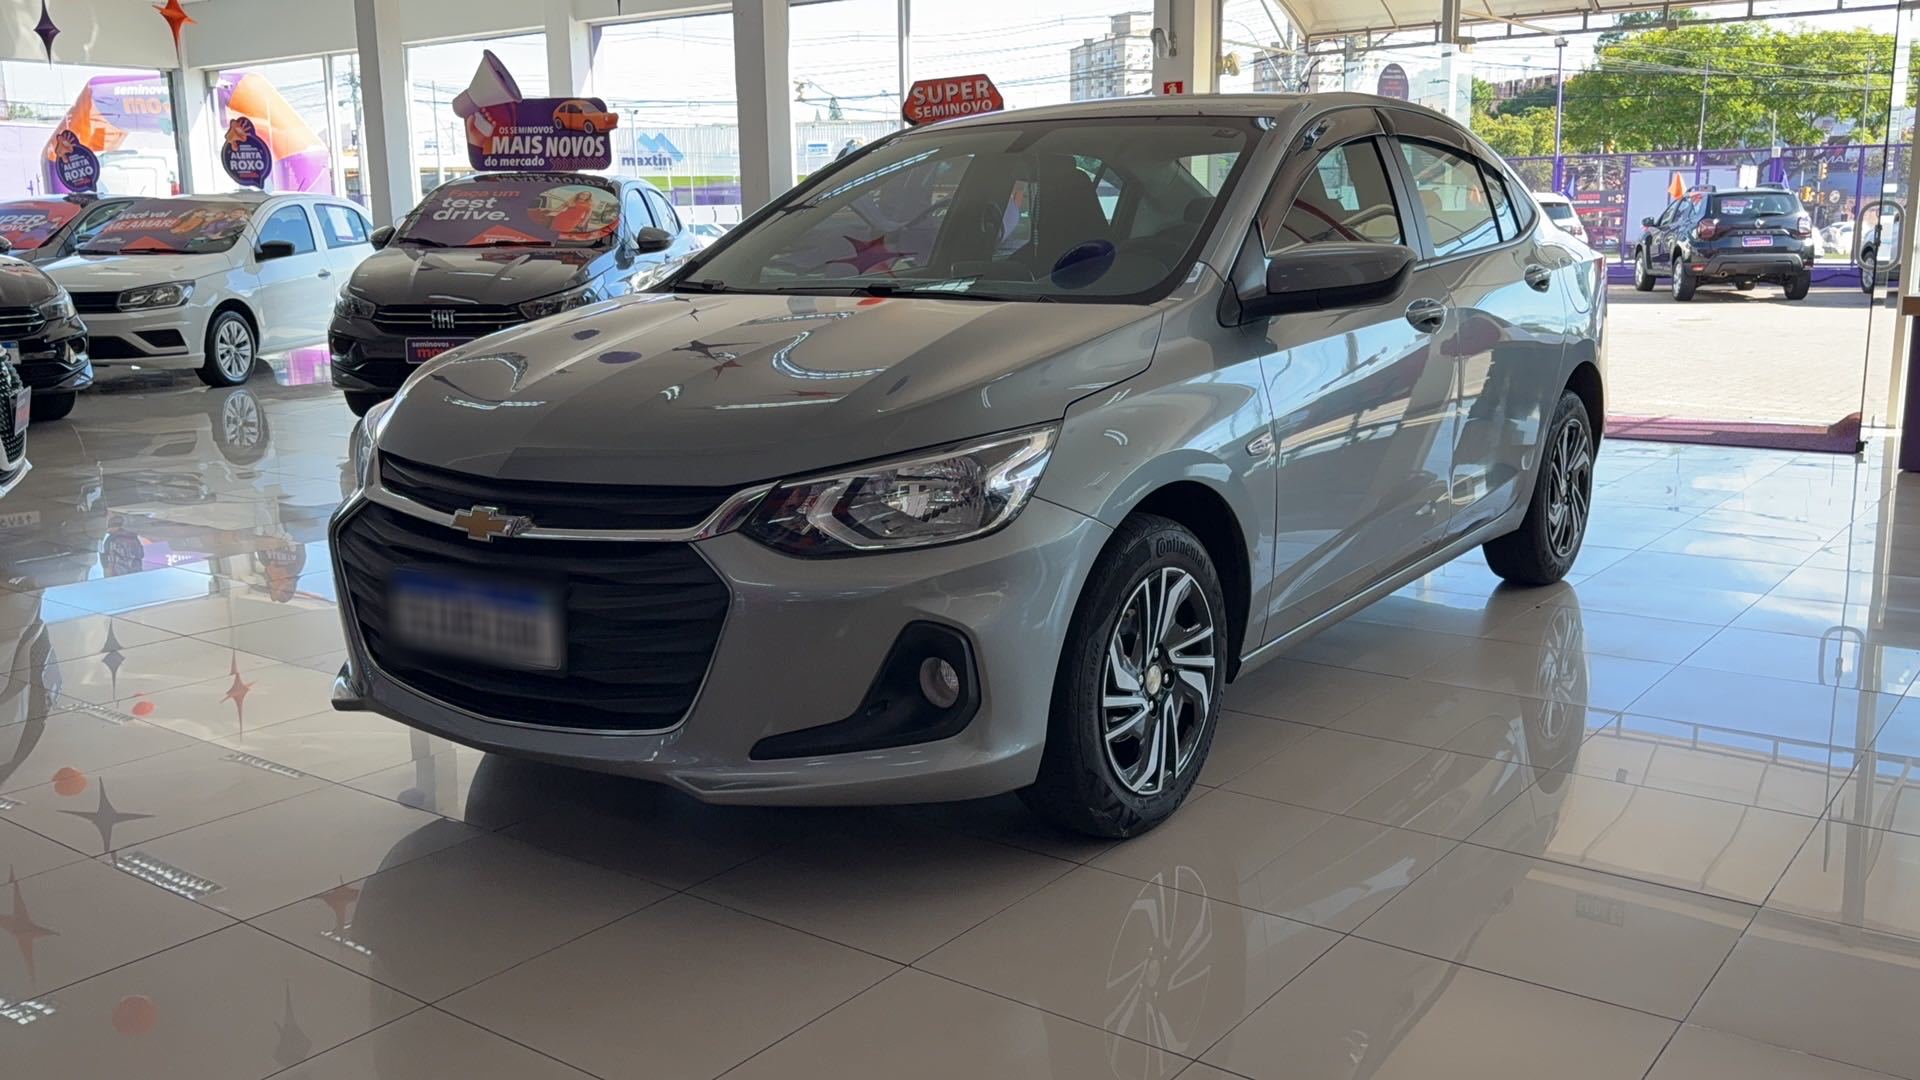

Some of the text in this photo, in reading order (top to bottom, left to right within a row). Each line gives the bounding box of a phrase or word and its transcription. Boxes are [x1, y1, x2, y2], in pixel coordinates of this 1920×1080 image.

[913, 80, 989, 105] SUPER
[914, 100, 993, 119] SEMINOVO
[499, 126, 554, 135] OS SEMINOVOS
[492, 136, 605, 157] MAIS NOVOS
[230, 151, 262, 160] ALERTA
[484, 156, 545, 166] do mercado
[621, 153, 673, 166] maxtin
[64, 158, 90, 171] ALERTA
[230, 160, 264, 170] ROXO
[64, 165, 94, 181] ROXO
[441, 197, 496, 209] test
[432, 207, 510, 220] drive.
[431, 309, 456, 329] FIAT
[1156, 536, 1207, 569] Continental
